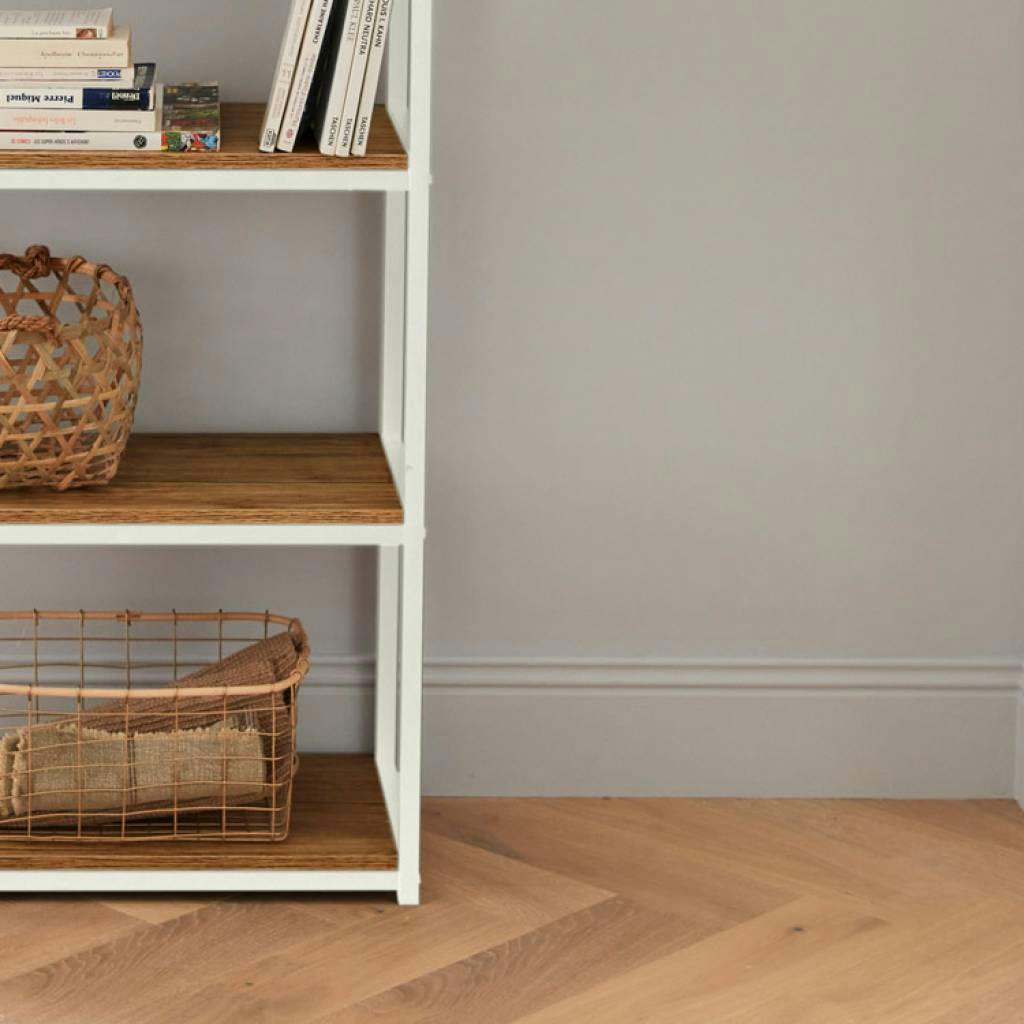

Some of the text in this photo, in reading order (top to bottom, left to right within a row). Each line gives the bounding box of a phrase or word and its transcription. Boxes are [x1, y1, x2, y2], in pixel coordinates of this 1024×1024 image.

[359, 23, 373, 55] NEUTRA
[375, 25, 385, 48] KAHN
[6, 92, 74, 103] Pierre Miquel
[327, 117, 338, 147] TASCHEN
[342, 118, 353, 148] TASCHEN
[357, 116, 368, 146] TASCHEN
